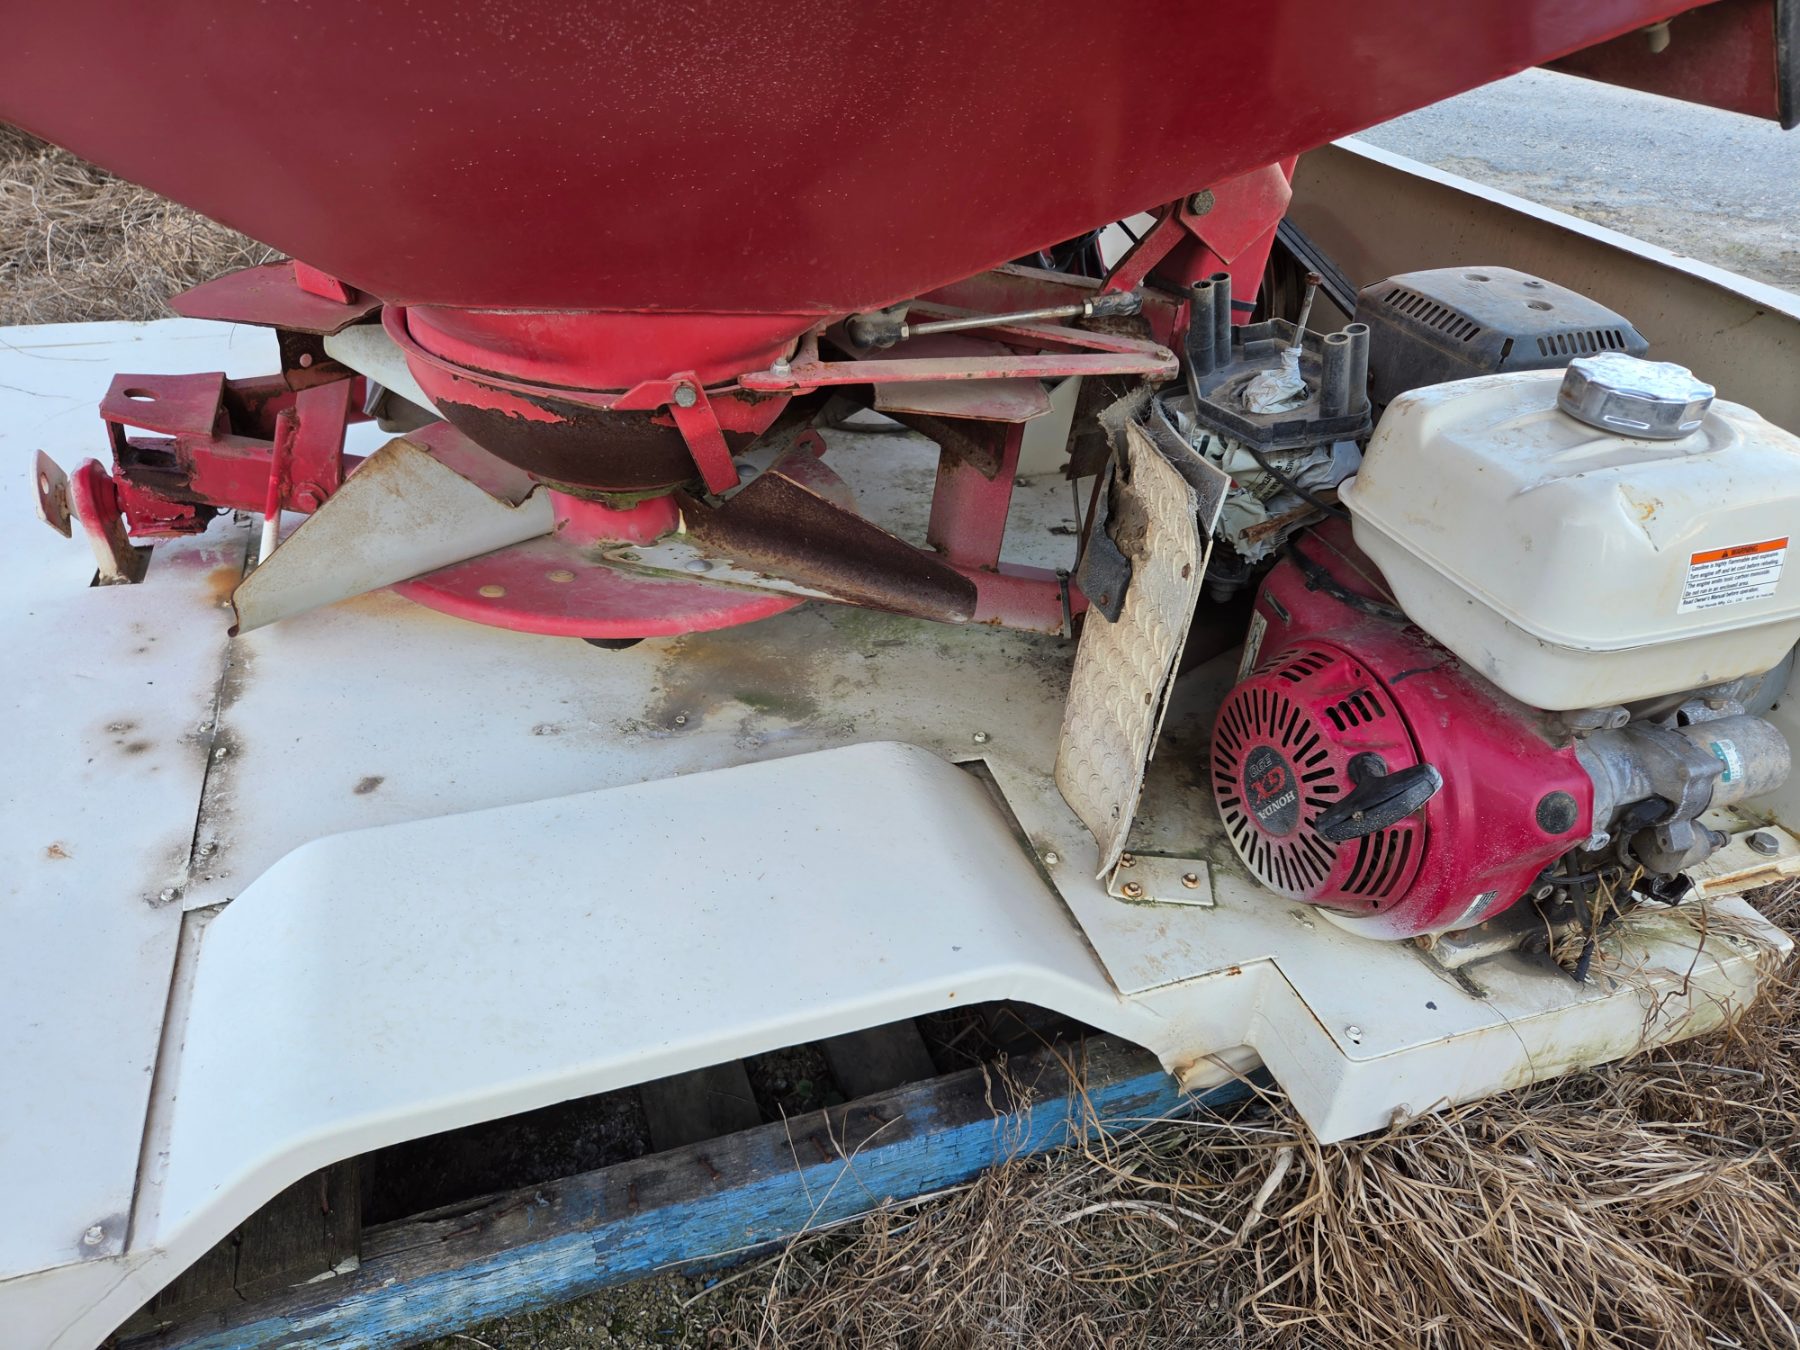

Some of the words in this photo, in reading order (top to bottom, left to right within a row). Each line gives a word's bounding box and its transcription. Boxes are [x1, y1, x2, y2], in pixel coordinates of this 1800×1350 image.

[1730, 545, 1759, 556] WARNING
[1250, 753, 1272, 777] 390
[1252, 766, 1286, 805] GX
[1257, 790, 1296, 819] HONDA
